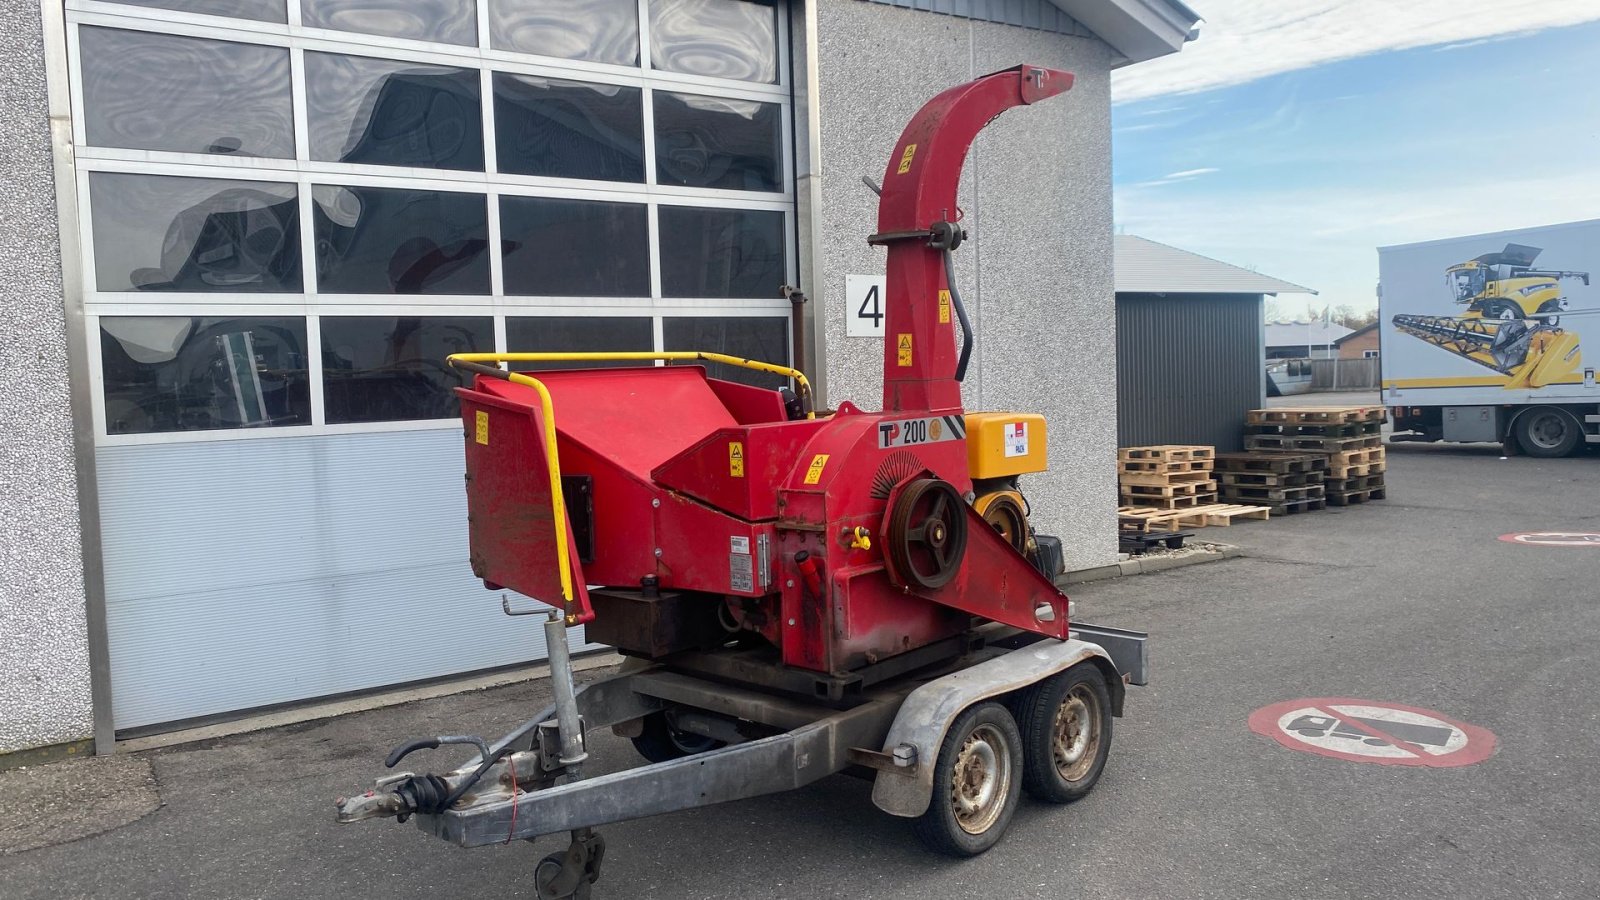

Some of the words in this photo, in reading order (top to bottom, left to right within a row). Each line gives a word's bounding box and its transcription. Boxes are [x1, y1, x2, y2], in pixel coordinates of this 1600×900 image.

[858, 285, 884, 328] 4
[880, 423, 900, 447] TP
[904, 420, 926, 444] 200
